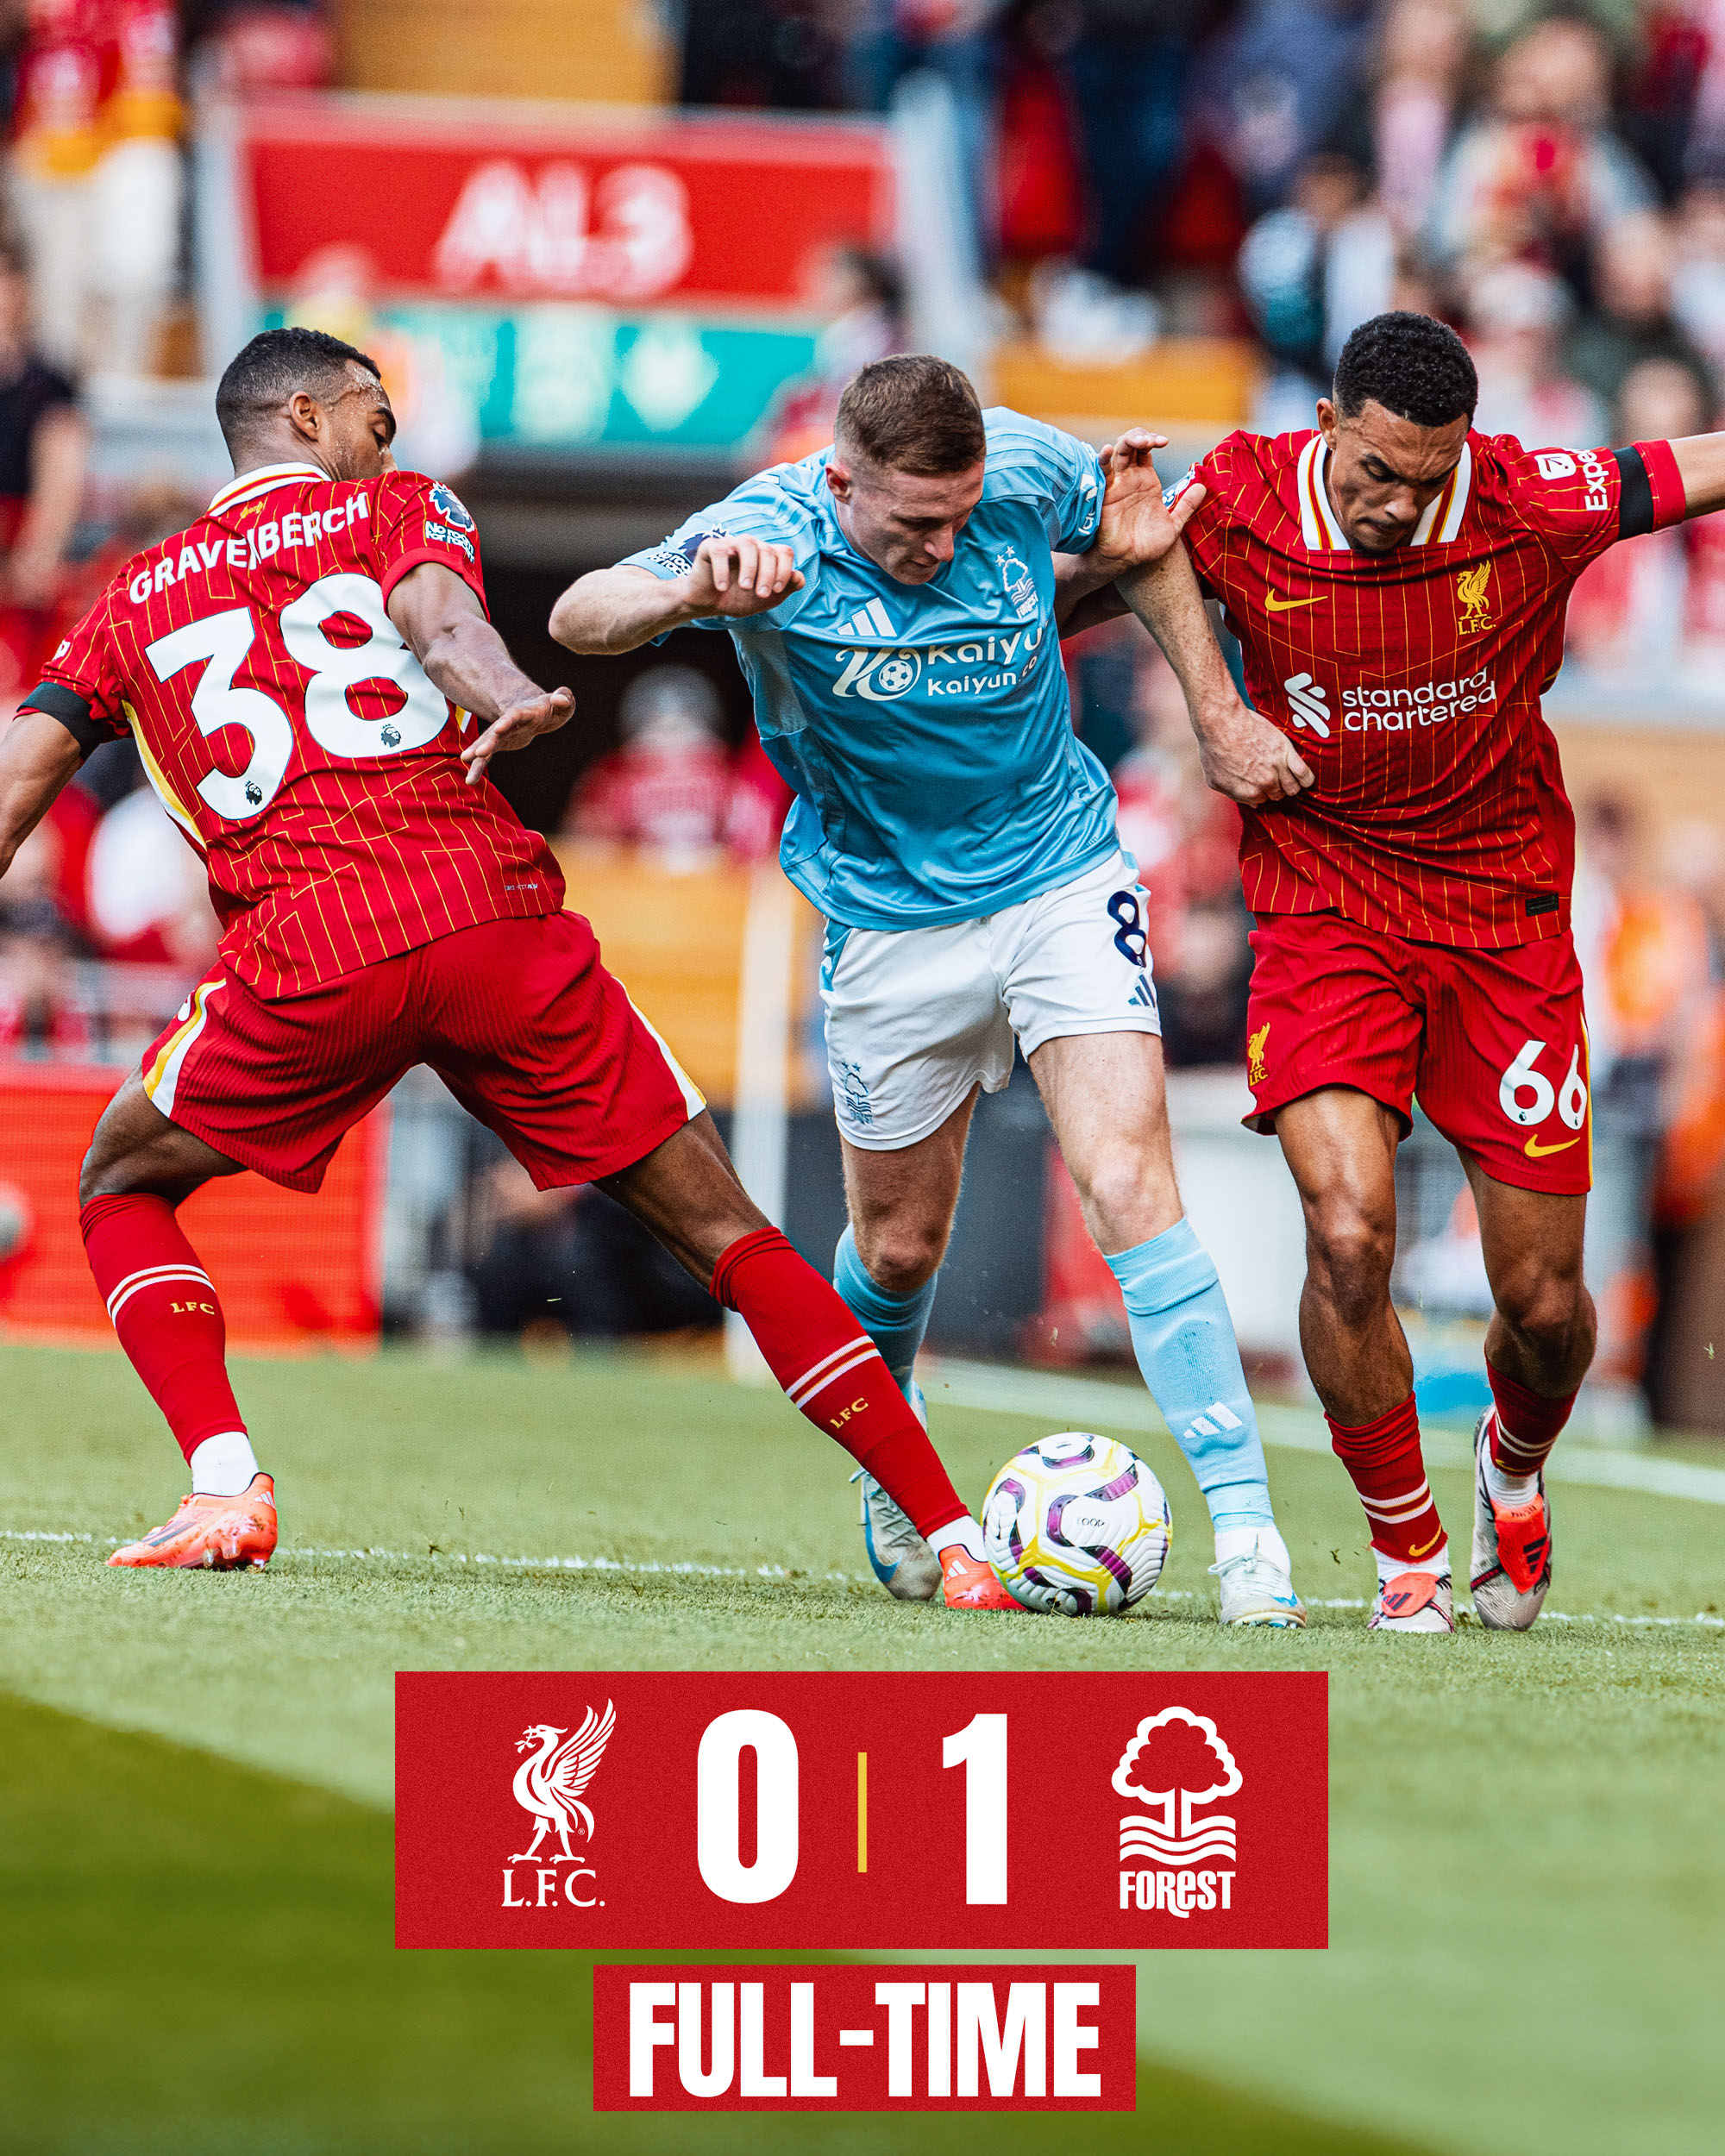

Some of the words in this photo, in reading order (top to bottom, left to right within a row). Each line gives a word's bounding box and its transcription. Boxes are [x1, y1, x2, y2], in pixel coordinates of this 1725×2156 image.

[1572, 448, 1609, 511] Expe
[669, 554, 692, 575] roo
[927, 621, 1048, 666] Kaiyu
[145, 573, 448, 820] 38
[1342, 666, 1487, 707] standard
[1344, 680, 1496, 731] chartered
[1107, 890, 1147, 968] 8
[1499, 1039, 1588, 1131] 66
[170, 1301, 215, 1315] LFC
[830, 1397, 869, 1429] LFC
